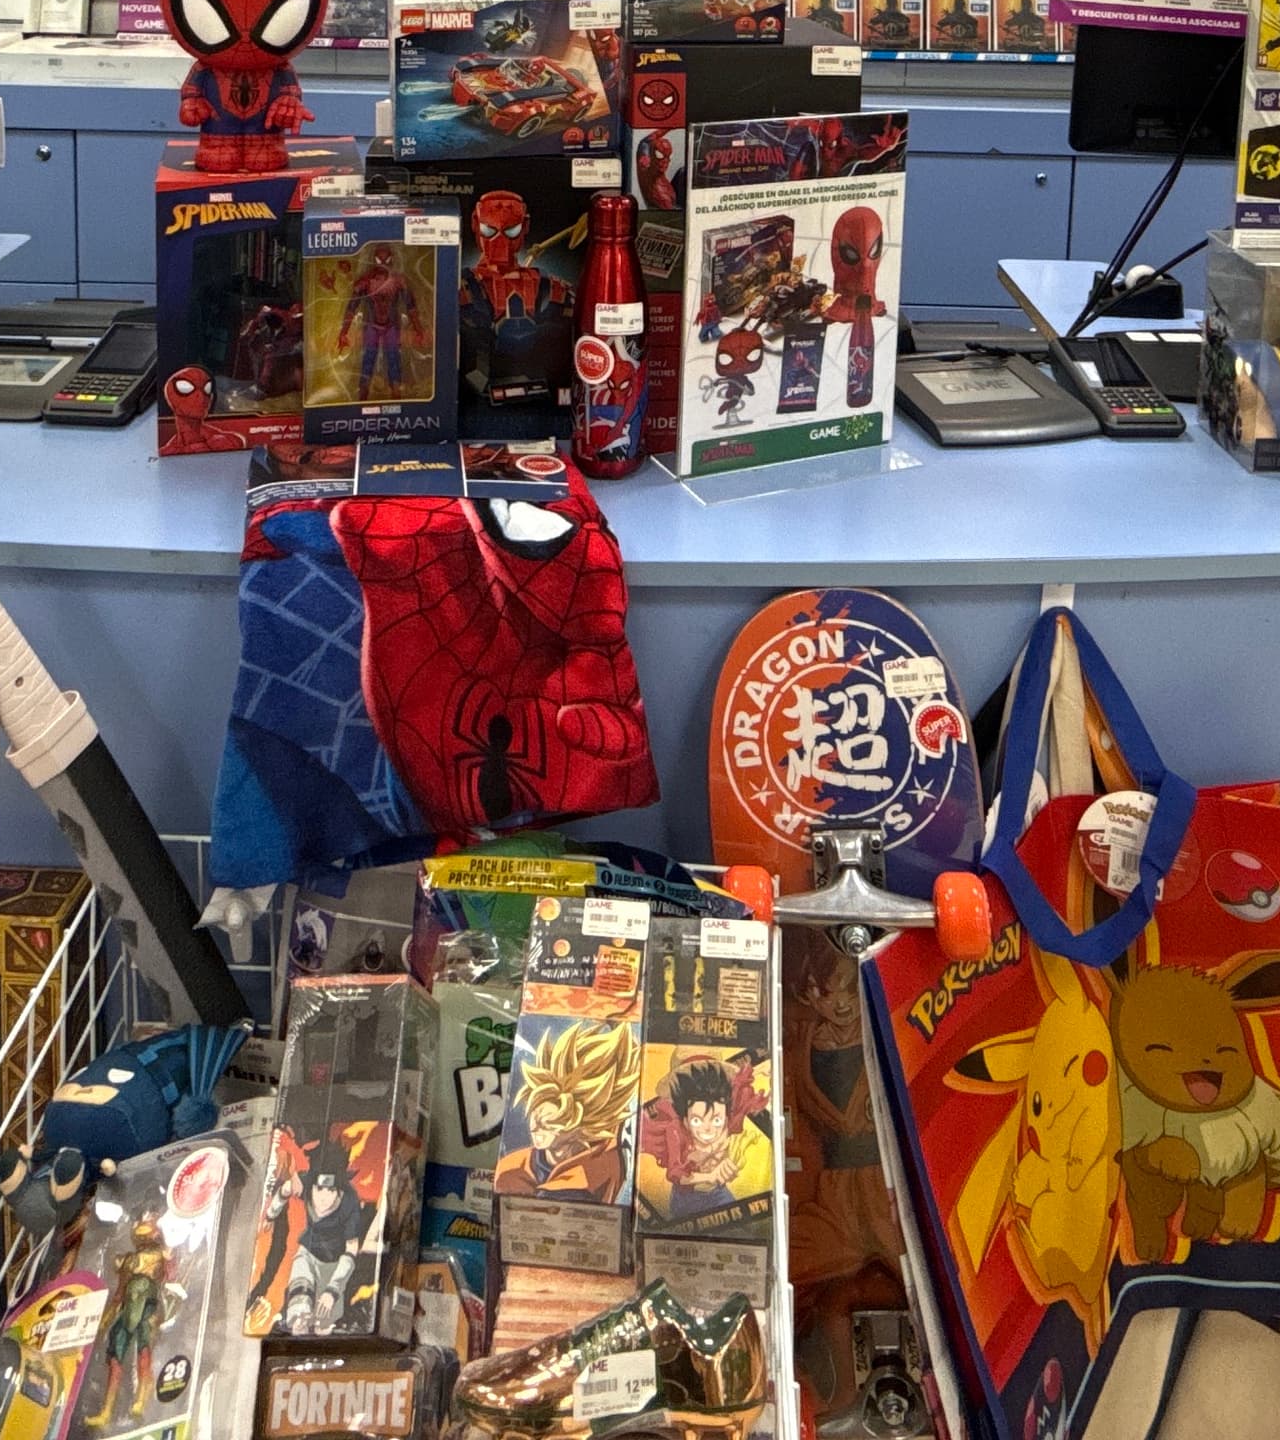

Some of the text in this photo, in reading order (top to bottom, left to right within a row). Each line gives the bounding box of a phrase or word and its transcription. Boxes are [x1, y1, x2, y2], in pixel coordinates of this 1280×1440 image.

[402, 13, 473, 30] LEGO MARVEL
[1079, 10, 1132, 21] DESCUENTOS
[1148, 16, 1185, 25] MARCAS
[1189, 18, 1240, 28] ASOCIADAS
[703, 147, 784, 173] SPIDER-MAN
[166, 202, 276, 235] SPIDER-MAN
[309, 232, 357, 248] LEGENDS
[322, 416, 440, 433] SPIDER-MAN
[810, 425, 840, 440] GAME
[734, 630, 844, 768] DRAGON
[921, 716, 952, 736] SÚPER
[783, 684, 892, 792] 超
[470, 859, 496, 873] PACK
[500, 860, 514, 873] DE
[164, 1361, 186, 1384] 28
[274, 1378, 409, 1428] FORTNITE
